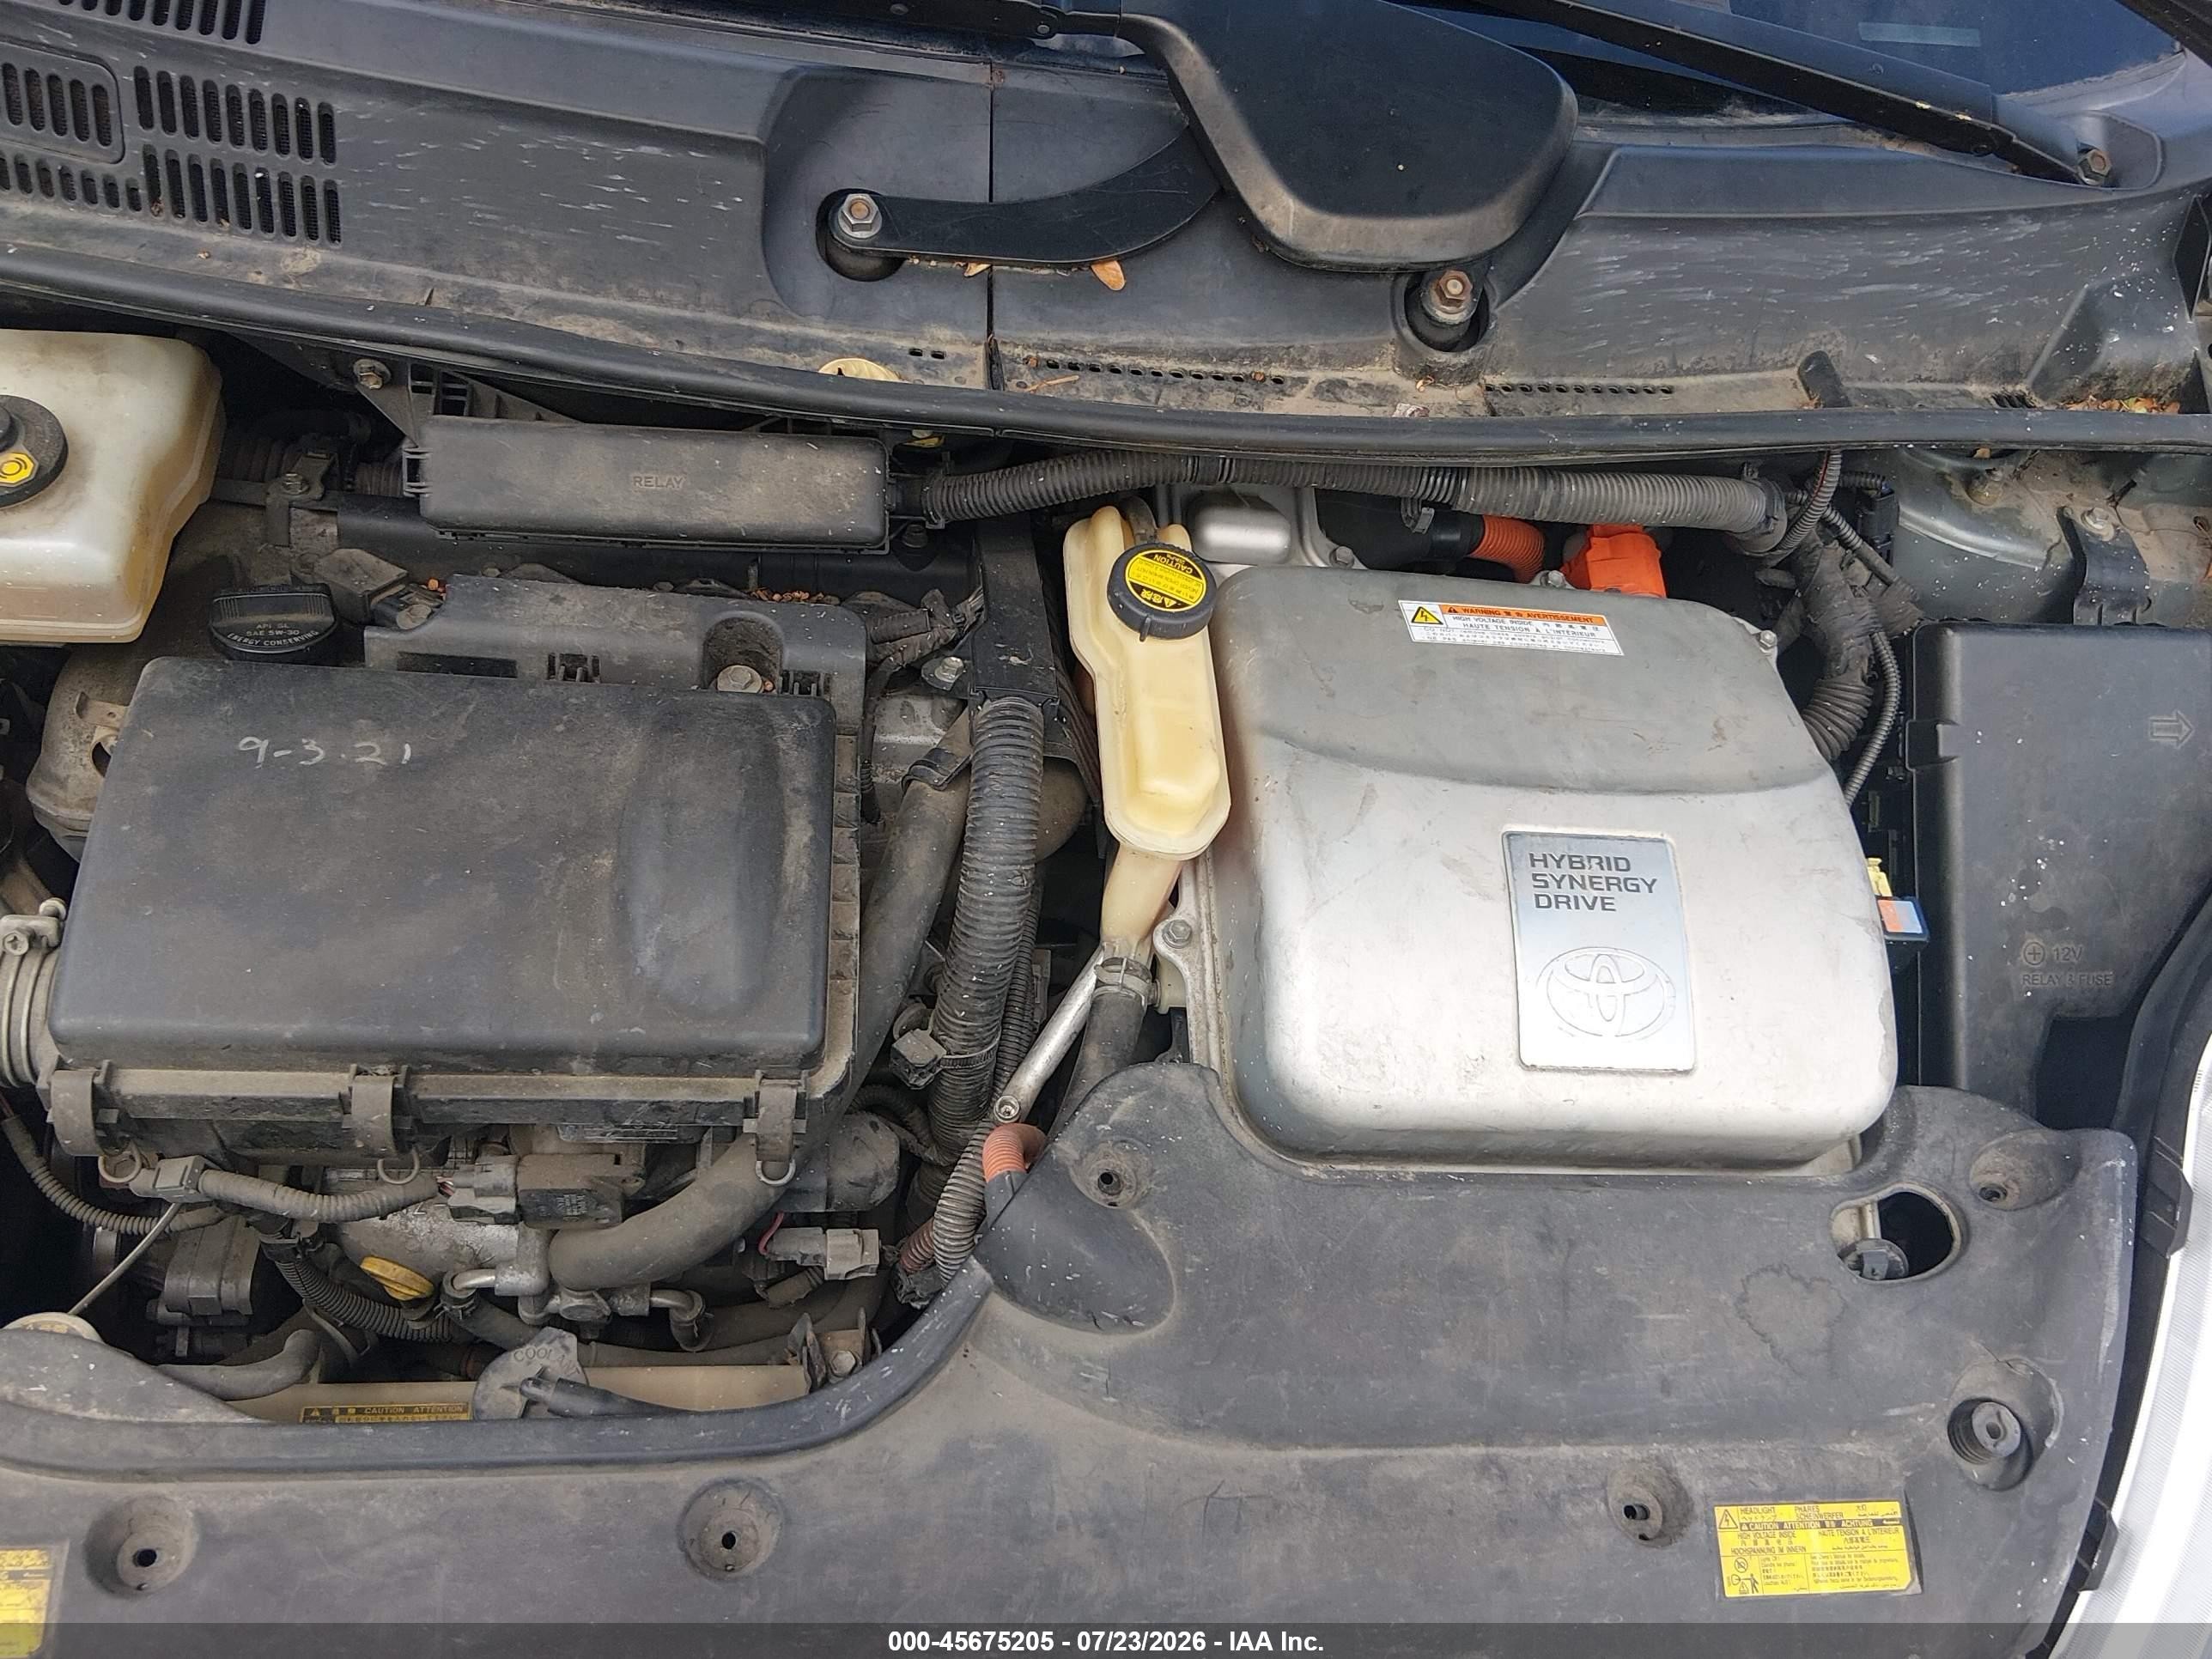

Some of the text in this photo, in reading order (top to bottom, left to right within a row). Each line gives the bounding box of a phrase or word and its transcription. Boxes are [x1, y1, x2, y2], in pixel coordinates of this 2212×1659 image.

[633, 476, 684, 489] RELAY
[1153, 554, 1193, 574] CAUTION
[1462, 608, 1502, 617] WARNING
[1527, 612, 1595, 623] AVERTISSEMENT
[1495, 624, 1531, 633] TENSION
[227, 630, 319, 647] ENERGY CONSERVING
[1528, 853, 1632, 872] HYBRID
[1532, 872, 1657, 894] SYNERGY
[1534, 893, 1617, 912] DRIVE
[2053, 945, 2083, 962] 12V
[2022, 974, 2062, 986] RELAY
[2079, 973, 2113, 986] FUSE
[414, 1405, 464, 1413] ATTENTION
